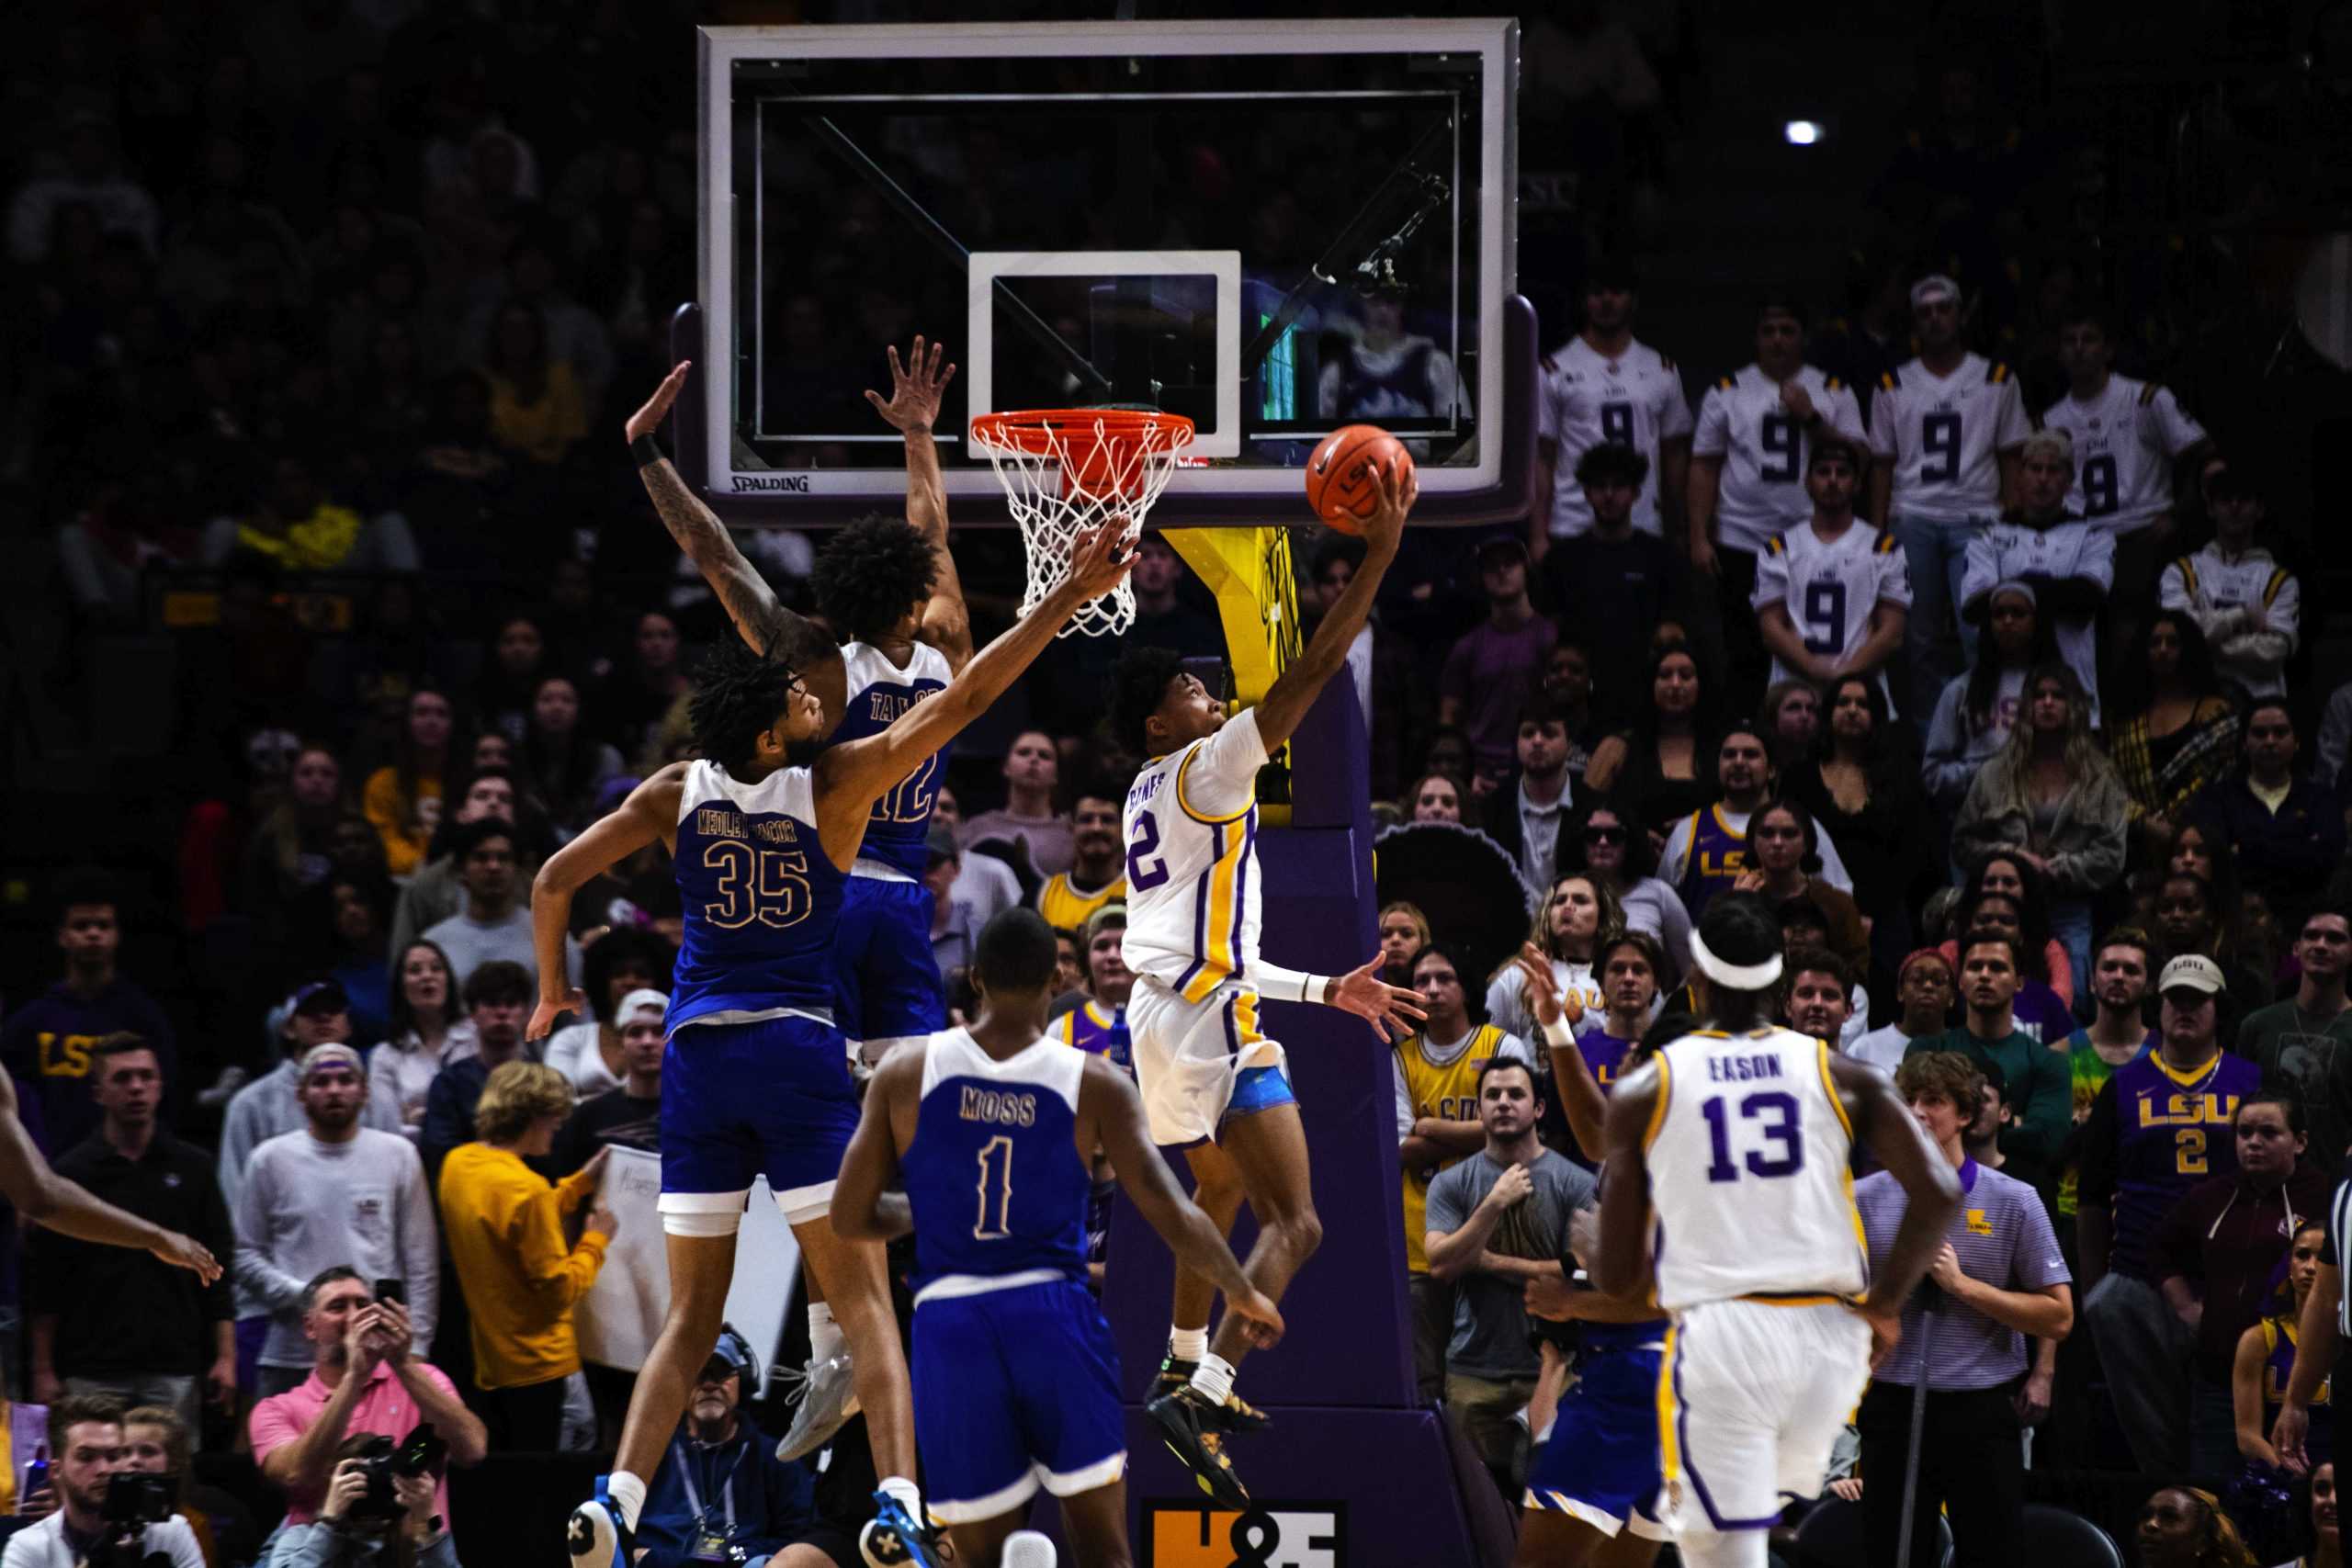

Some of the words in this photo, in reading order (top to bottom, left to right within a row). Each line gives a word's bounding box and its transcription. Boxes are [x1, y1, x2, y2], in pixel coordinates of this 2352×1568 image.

[1761, 414, 1801, 481] 9
[1921, 414, 1962, 481] 9
[731, 475, 809, 493] SPALDING
[1805, 581, 1847, 654] 9
[1127, 809, 1170, 893] 2
[1701, 851, 1747, 877] LS
[704, 840, 813, 929] 35
[38, 1031, 99, 1078] LS
[1709, 1055, 1781, 1082] EASON
[959, 1084, 1037, 1128] MOSS
[2139, 1092, 2241, 1130] LSU
[1702, 1092, 1803, 1183] 13
[2175, 1128, 2209, 1175] 2
[972, 1134, 1014, 1241] 1
